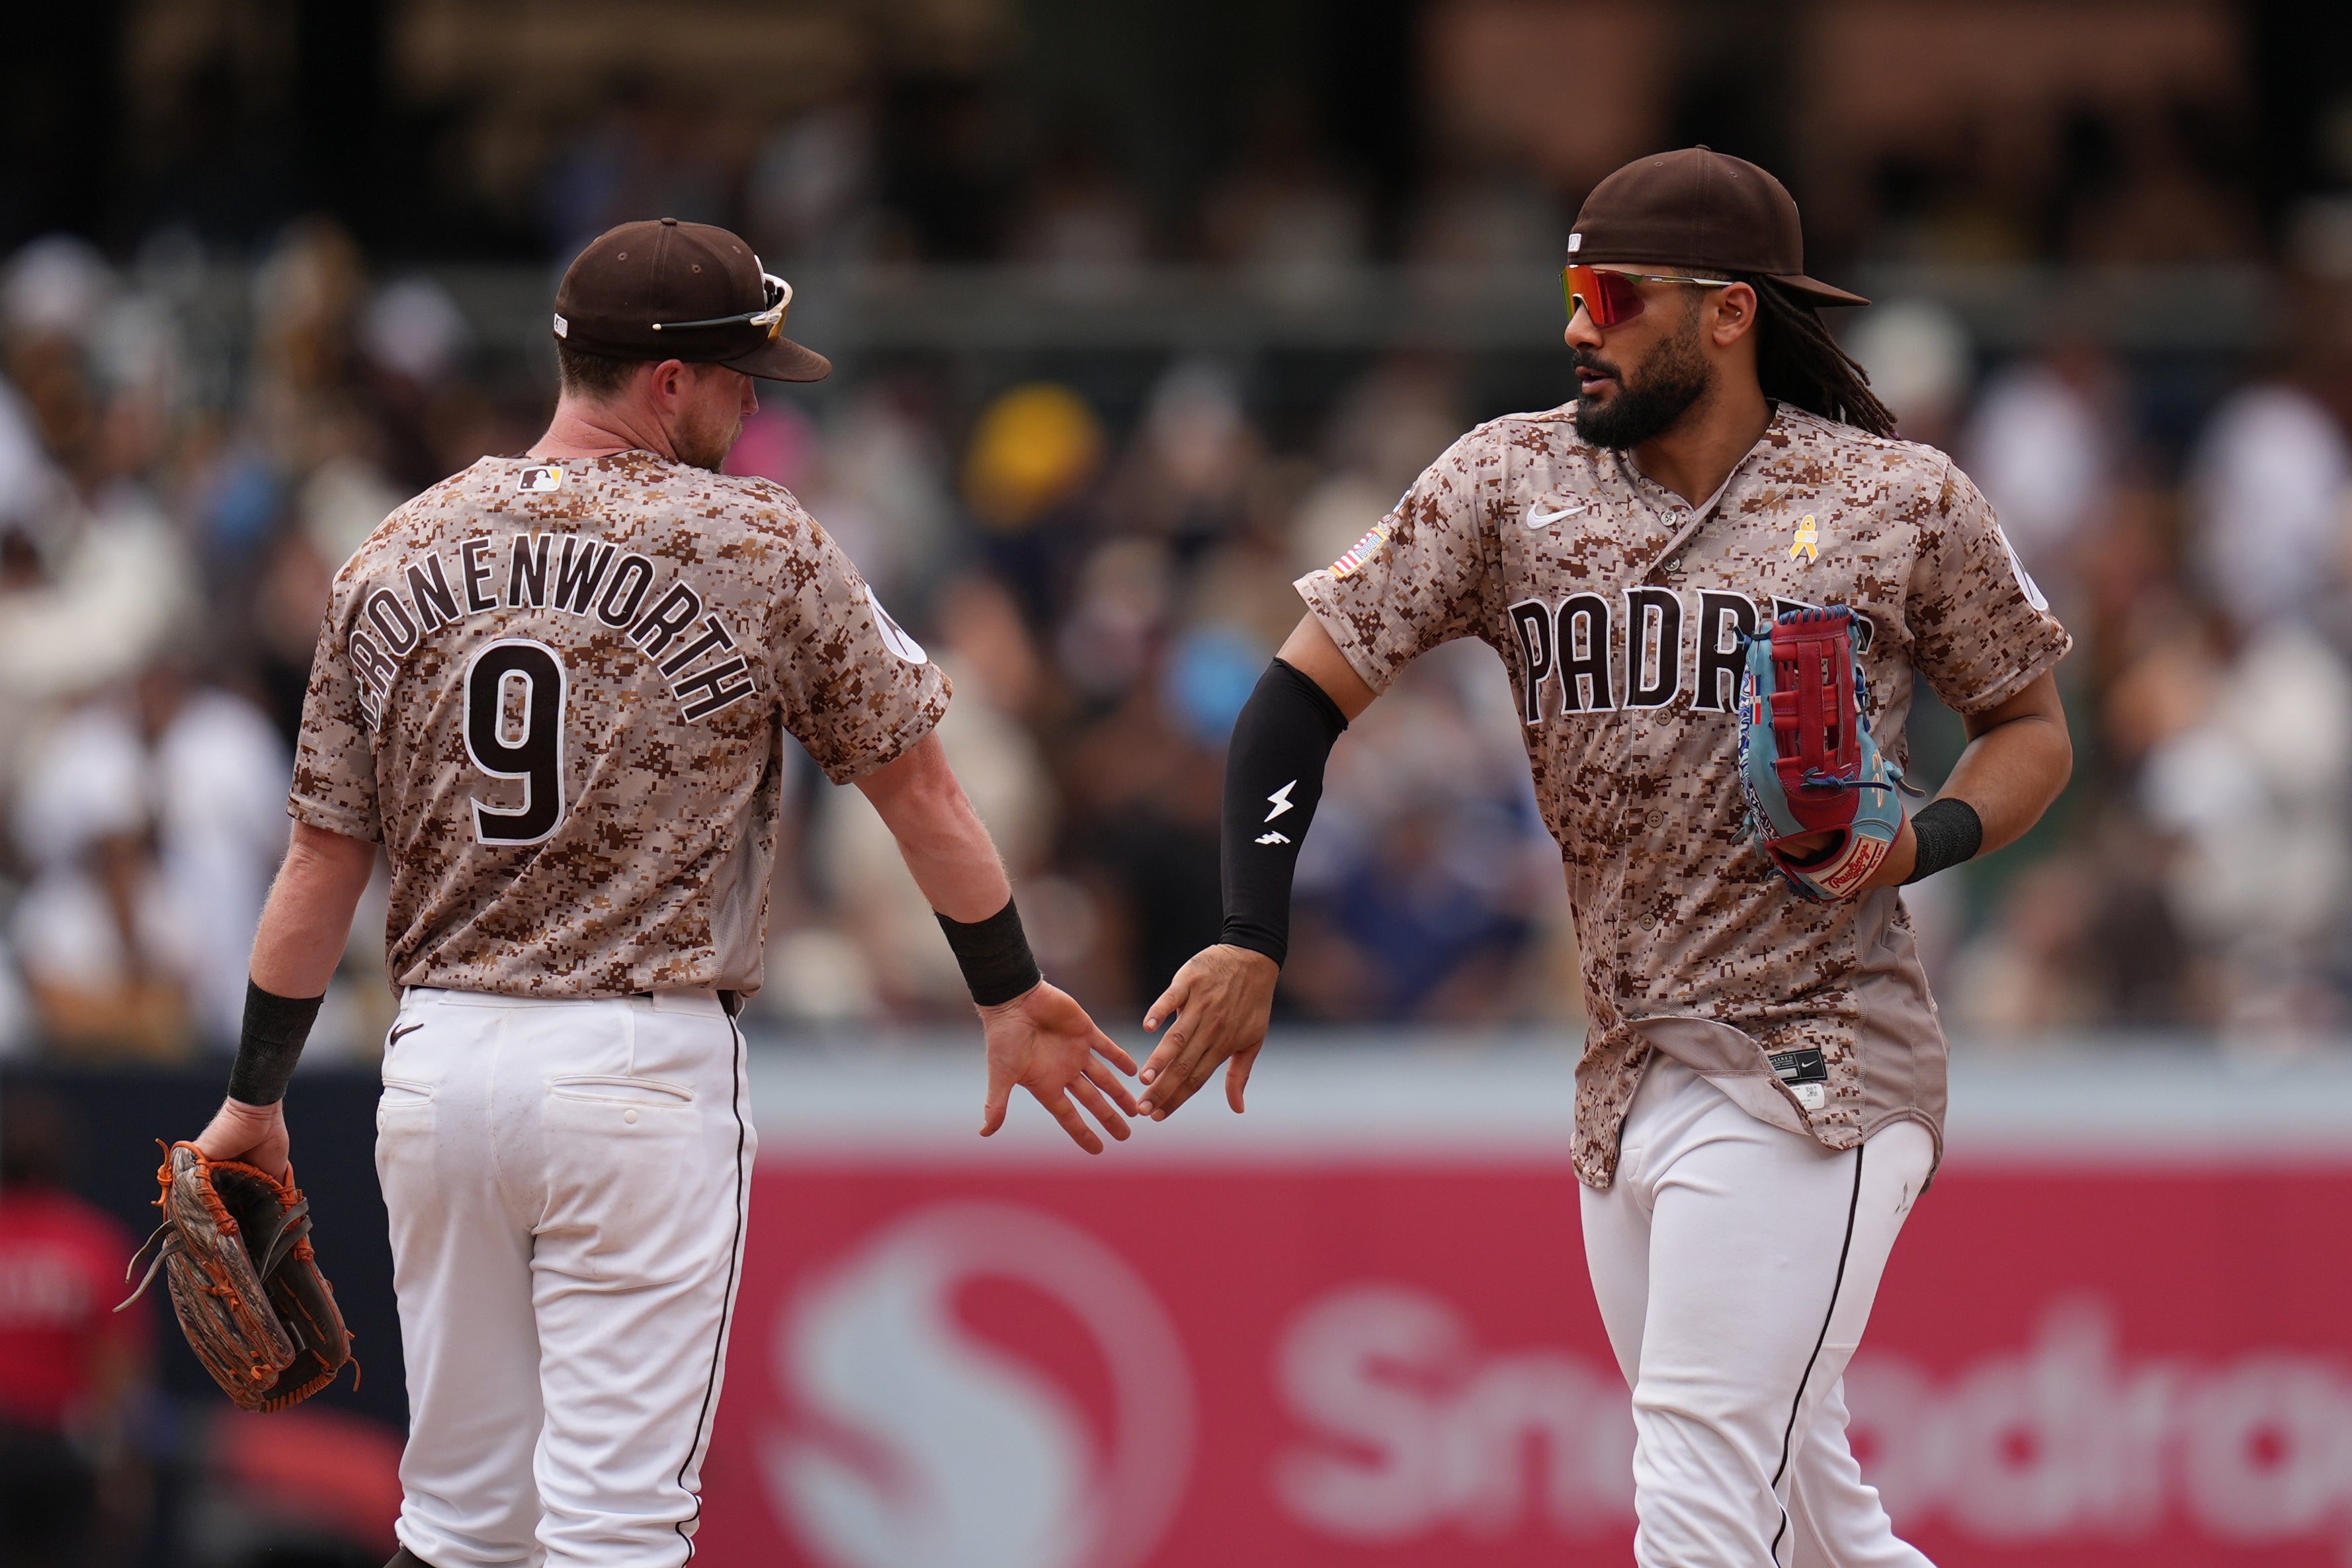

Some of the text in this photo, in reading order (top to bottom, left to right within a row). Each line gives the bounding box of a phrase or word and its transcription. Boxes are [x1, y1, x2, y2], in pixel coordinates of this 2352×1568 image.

[1508, 587, 1874, 724] PADR
[464, 638, 567, 846] 9
[1828, 843, 1870, 888] Rawlings
